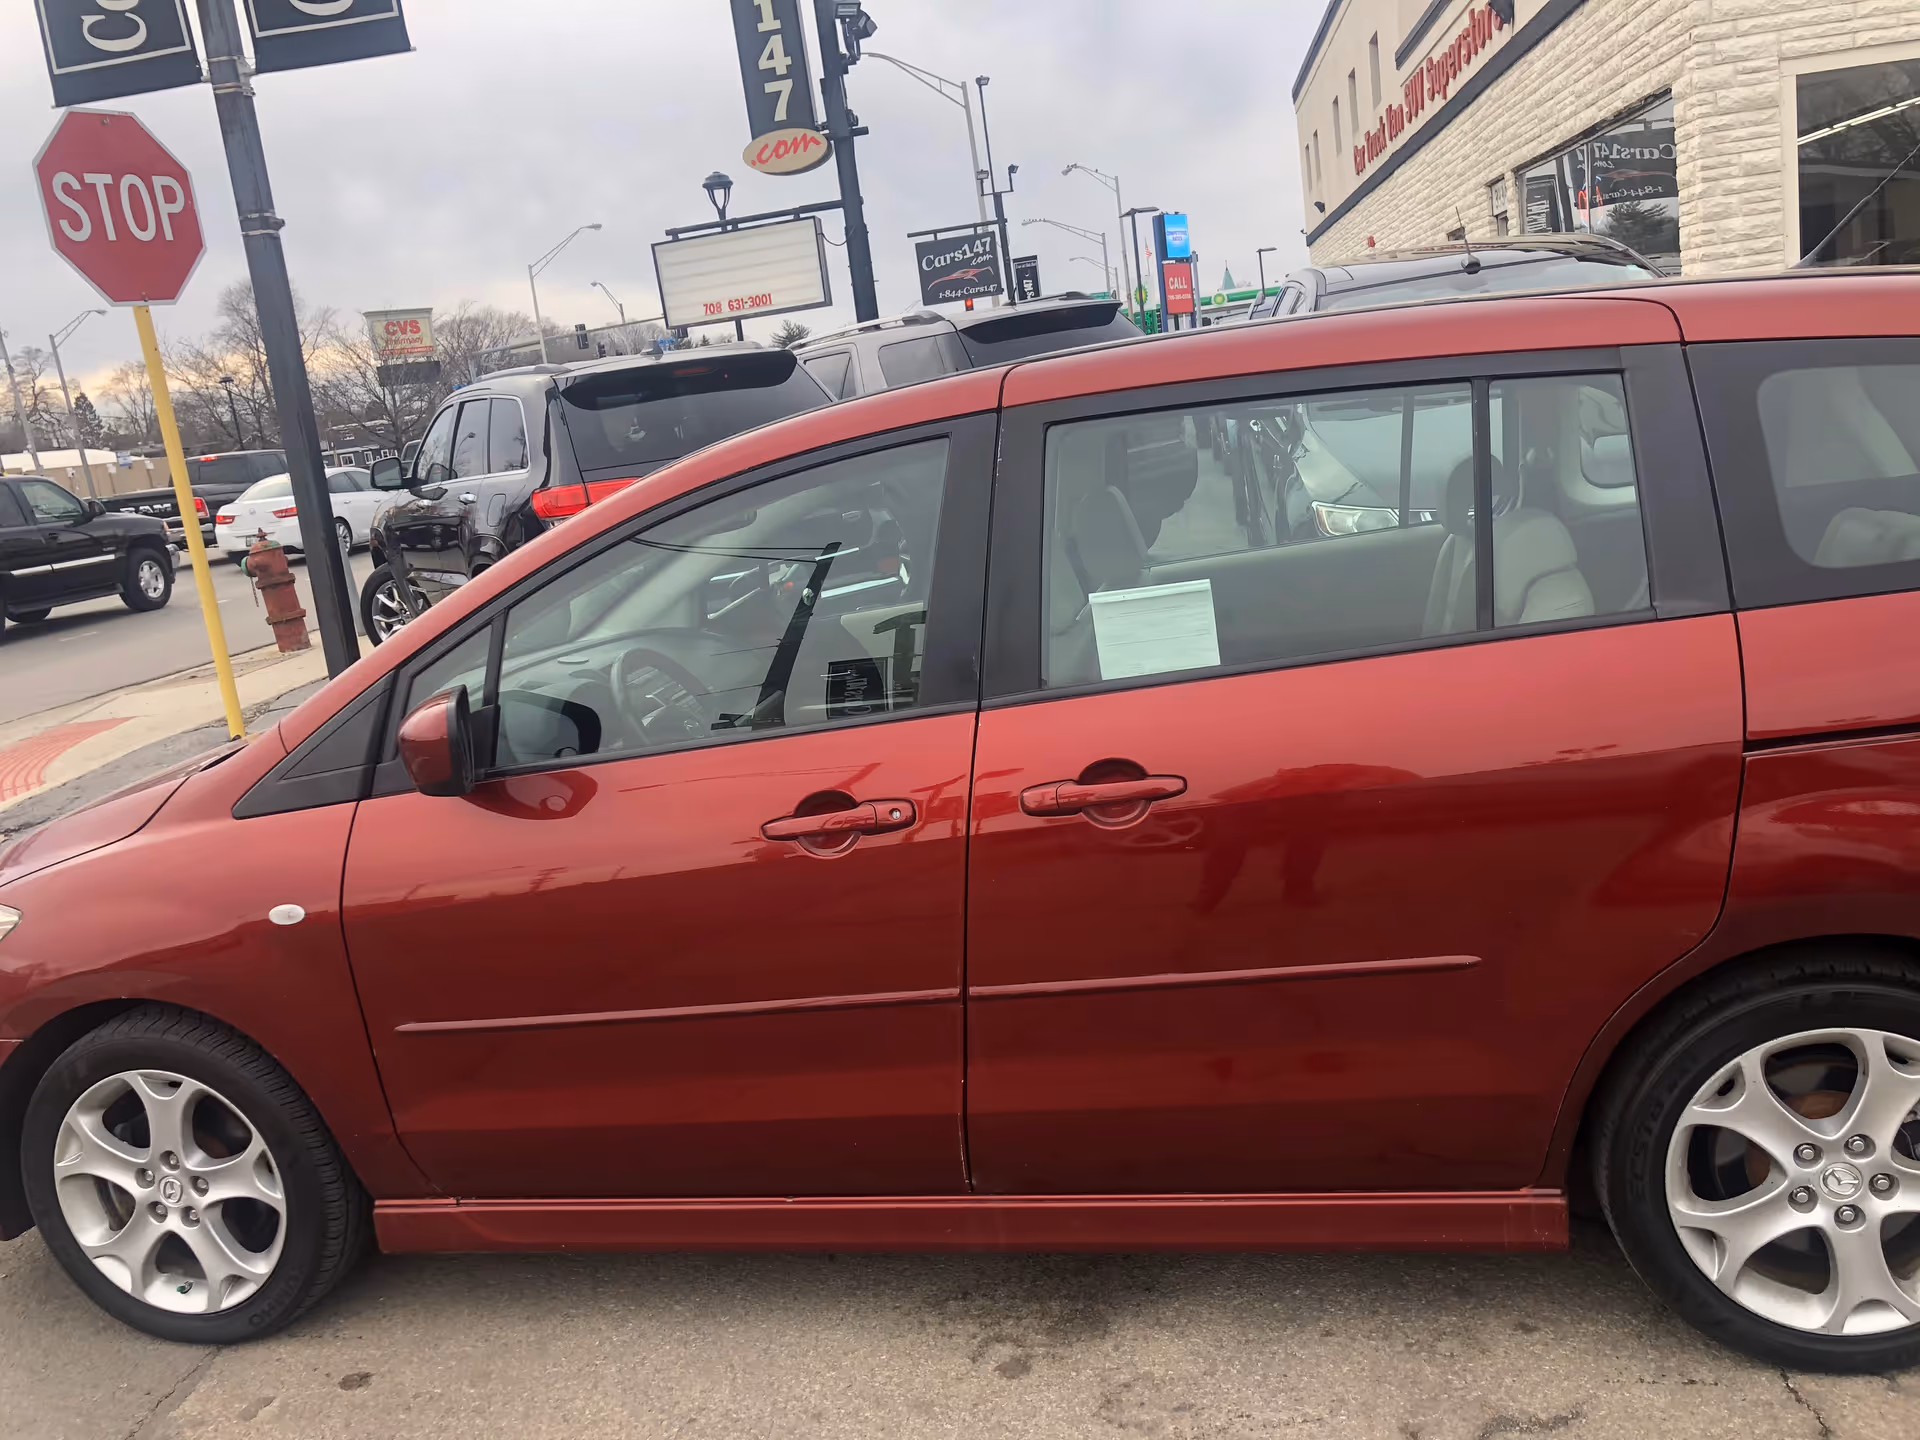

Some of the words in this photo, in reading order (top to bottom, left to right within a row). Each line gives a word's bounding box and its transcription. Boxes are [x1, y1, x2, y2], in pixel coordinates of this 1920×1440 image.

[1353, 144, 1366, 176] Car
[1365, 115, 1388, 164] Truck
[1385, 103, 1405, 142] Van
[1404, 66, 1425, 124] SUV
[750, 132, 822, 167] .com
[52, 171, 185, 242] STOP
[921, 237, 992, 271] Cars147
[970, 254, 994, 266] .com
[938, 283, 998, 299] 1-844-Cars147
[1168, 276, 1188, 290] CALL
[703, 301, 722, 316] 708
[728, 292, 773, 311] 631-3001
[384, 319, 421, 337] CVS
